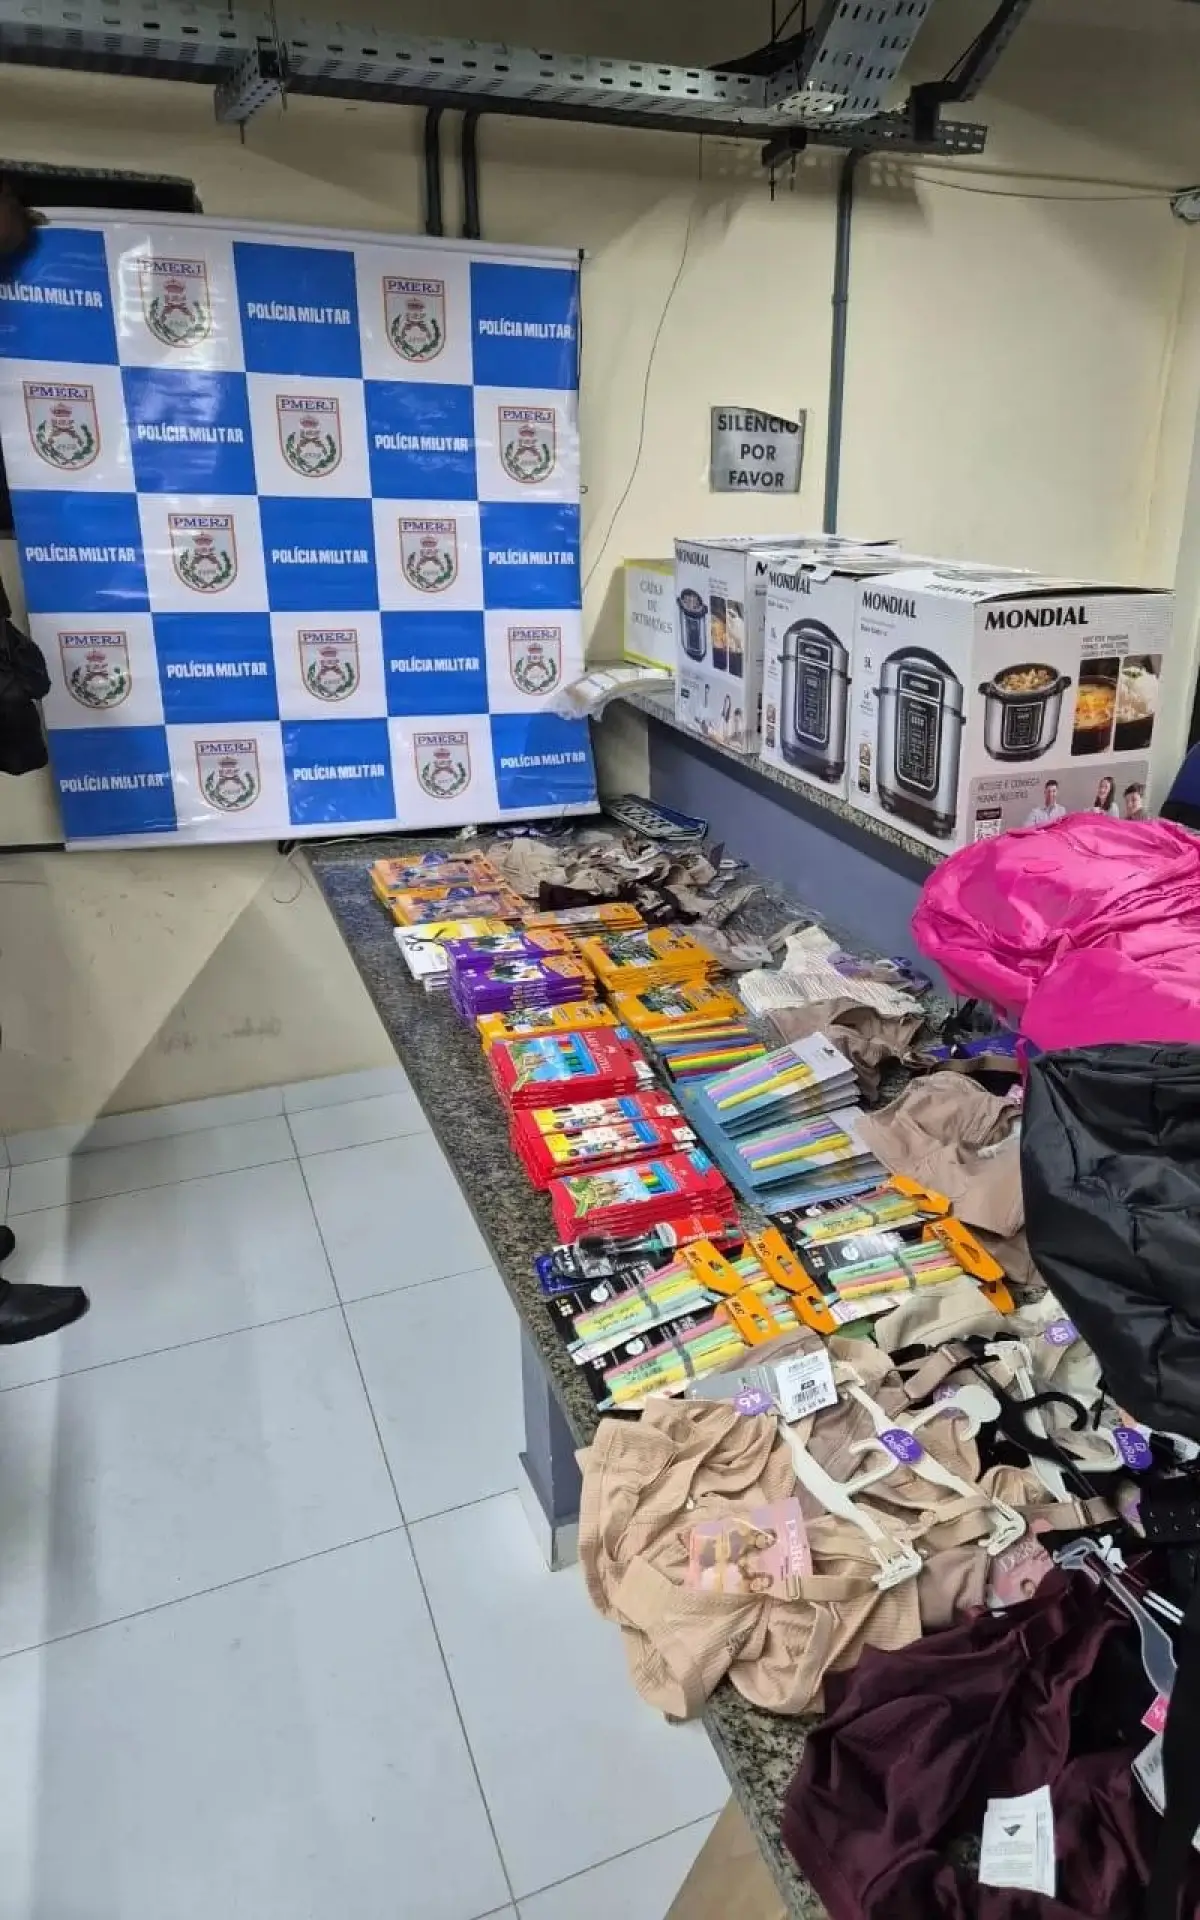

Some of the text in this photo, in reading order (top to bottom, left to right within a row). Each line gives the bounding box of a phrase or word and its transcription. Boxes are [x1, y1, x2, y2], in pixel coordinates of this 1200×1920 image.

[0, 281, 103, 308] OLÍCIA MILITAR
[387, 280, 441, 293] PMERJ
[248, 301, 351, 325] POLÍCIA MILITAR
[479, 317, 574, 341] POLÍCIA MILITAR
[29, 386, 88, 399] PMERJ
[281, 399, 334, 411] PMERJ
[503, 409, 552, 422] PMERJ
[137, 423, 244, 444] POLÍCIA MILITAR
[375, 432, 469, 452] POLÍCIA MILITAR
[740, 443, 777, 461] POR
[728, 470, 786, 488] FAVOR
[174, 516, 229, 528] PMERJ
[402, 520, 453, 533] PMERJ
[26, 543, 136, 562] POLÍCIA MILITAR
[272, 547, 368, 564] POLÍCIA MILITAR
[489, 547, 574, 565] POLÍCIA MILITAR
[676, 546, 711, 569] MONDIAL
[768, 571, 812, 595] MONDIAL
[862, 590, 917, 619] MONDIAL
[984, 605, 1089, 631] MONDIAL
[65, 635, 122, 646] PMERJ
[303, 632, 354, 642] PMERJ
[512, 629, 558, 640] PMERJ
[167, 660, 268, 679] POLÍCIA MILITAR
[391, 655, 479, 673] POLÍCIA MILITAR
[199, 741, 254, 753] PMERJ
[418, 734, 466, 745] PMERJ
[501, 752, 586, 769] POLÍCIA MILITAR
[293, 764, 385, 782] POLÍCIA MILITAR
[60, 773, 163, 793] POLÍCIA MILITAR
